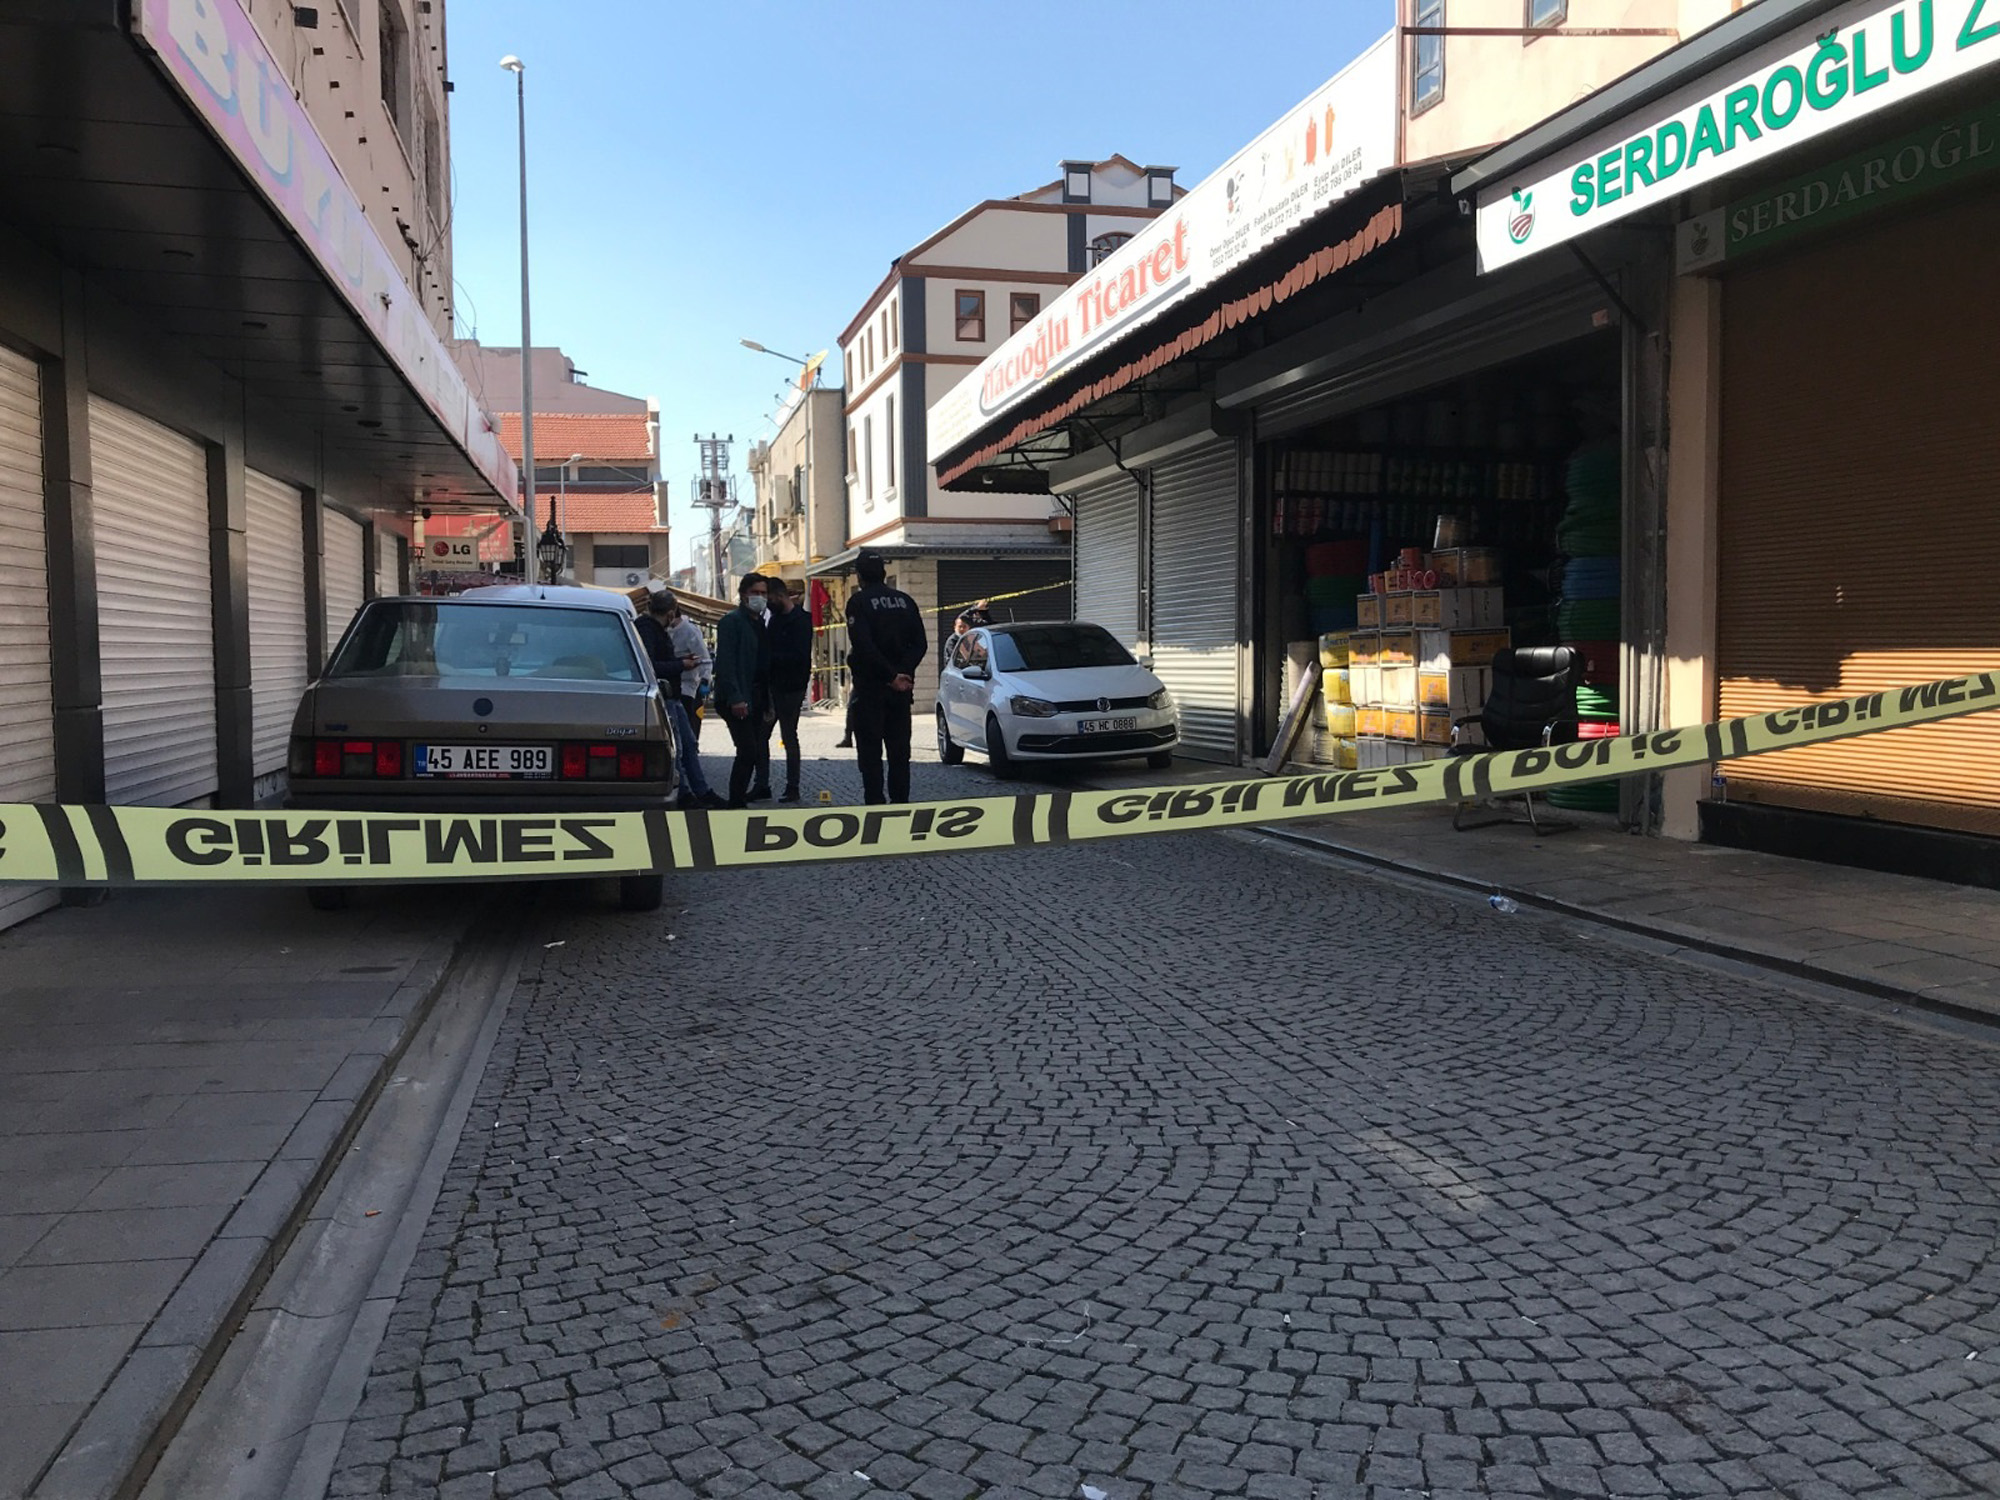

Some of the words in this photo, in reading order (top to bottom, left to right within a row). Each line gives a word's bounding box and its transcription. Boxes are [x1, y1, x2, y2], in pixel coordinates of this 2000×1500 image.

[1570, 0, 1934, 217] SERDAROĞLU
[1731, 114, 2000, 243] SERDAROĞL
[1077, 217, 1190, 338] Ticaret
[453, 544, 471, 555] LG
[429, 749, 452, 769] 45
[463, 749, 500, 769] AEE
[510, 749, 547, 769] 989
[1084, 722, 1095, 732] 45
[1099, 720, 1110, 731] HC
